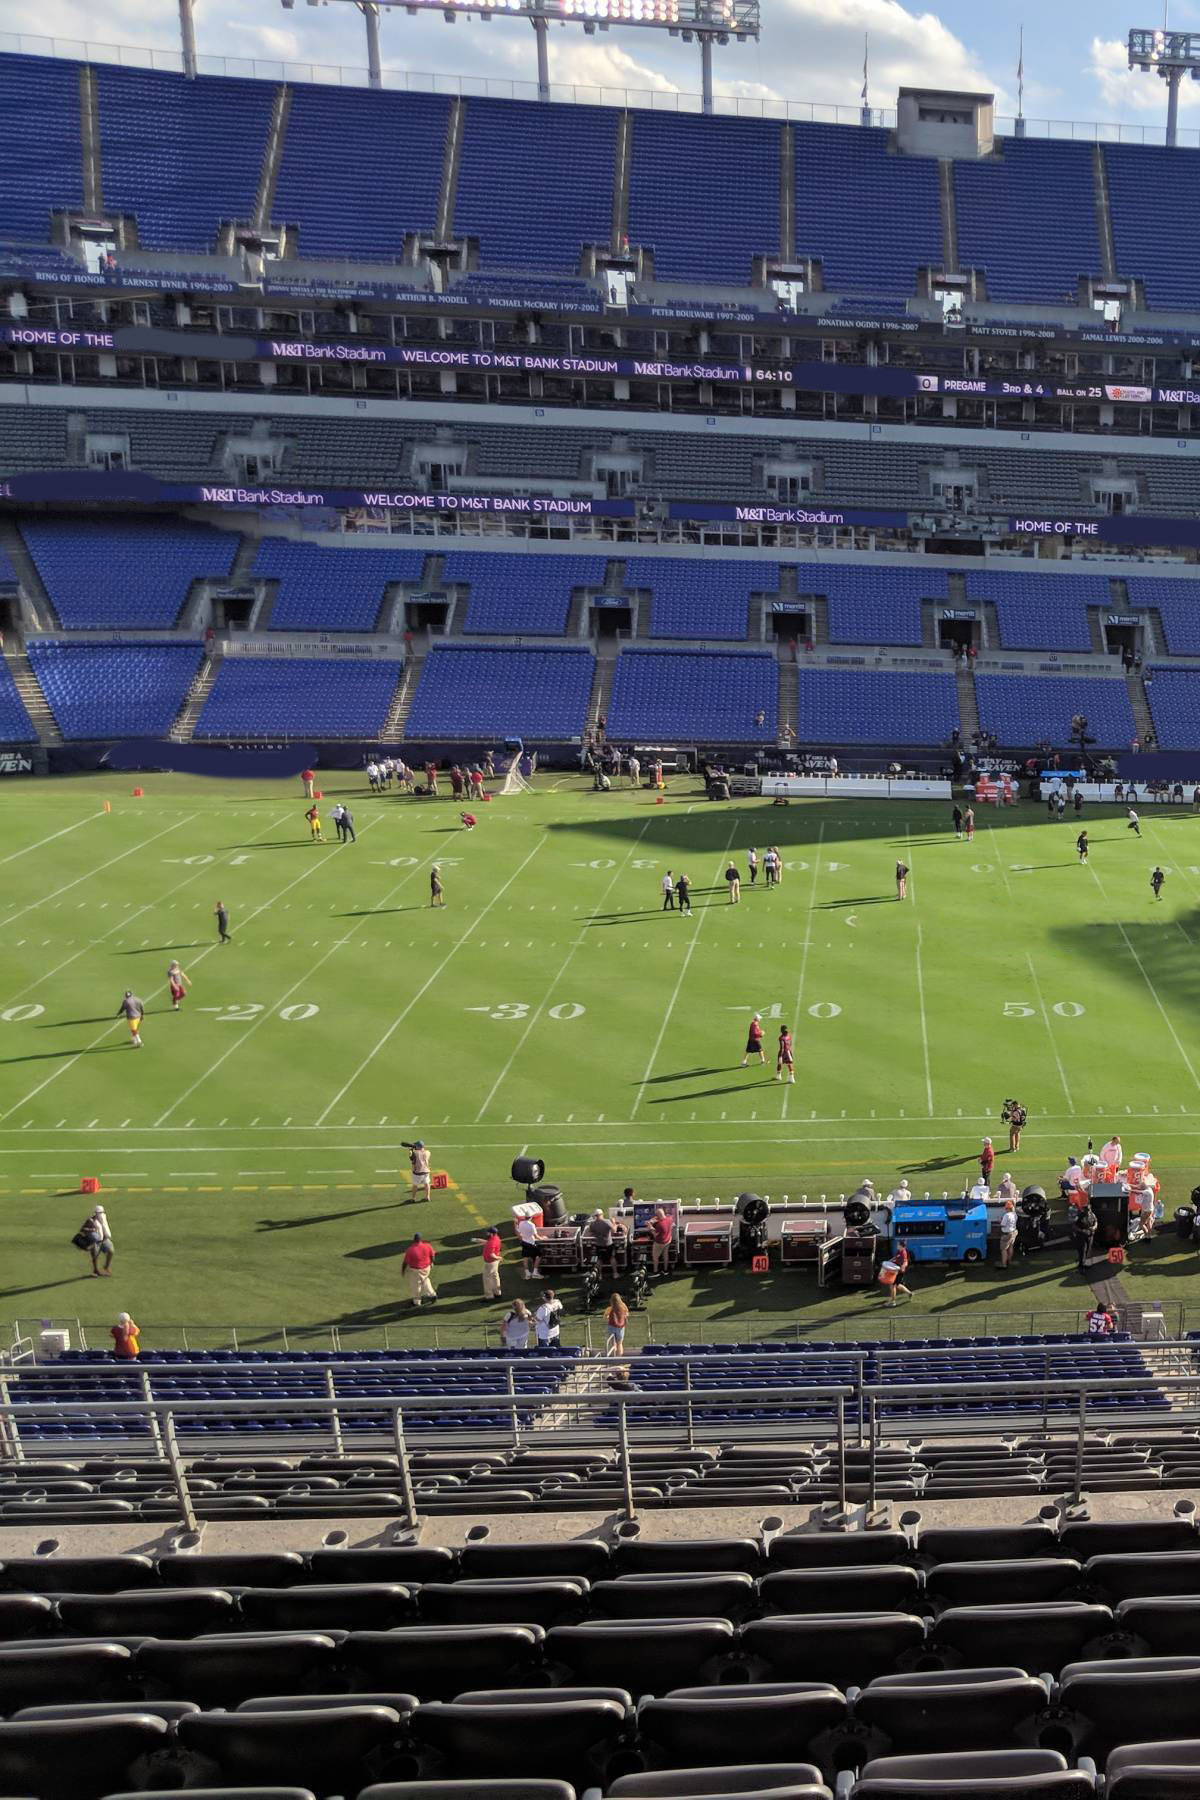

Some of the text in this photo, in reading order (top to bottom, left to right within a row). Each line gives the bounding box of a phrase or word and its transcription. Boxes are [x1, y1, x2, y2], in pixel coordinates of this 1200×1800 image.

[36, 272, 106, 285] RING OF HONOR
[122, 278, 158, 288] EARNEST
[160, 279, 188, 290] BYNER
[396, 293, 428, 302] ARTHUR
[438, 296, 469, 305] MODELL
[488, 298, 521, 308] MICHAEL
[651, 308, 674, 316] PETER
[675, 309, 714, 319] BOULWARE
[817, 318, 854, 328] JONATHAN
[855, 319, 880, 329] OGDEN
[971, 326, 990, 335] MATT
[991, 327, 1017, 336] STOVER
[1082, 332, 1104, 341] JAMAL
[1105, 334, 1126, 342] LEWIS
[12, 330, 114, 347] HOME OF THE
[272, 342, 386, 360] M&T Bank Stadium
[402, 350, 618, 372] WELCOME TO M&T BANK STADIUM
[633, 361, 739, 379] M&T Bank Stadium
[756, 369, 792, 381] 64:10
[922, 378, 931, 389] 0
[944, 379, 986, 391] PREGAME
[1002, 382, 1044, 394] 3RD & 4
[1056, 387, 1102, 398] BALL ON 25
[1158, 389, 1187, 402] M&T
[201, 488, 324, 505] M&T Bank Stadium
[364, 494, 592, 513] WELCOME TO M&T BANK STADIUM
[736, 507, 844, 524] M&T Bank Stadium
[1015, 520, 1099, 535] HOME OF THE
[489, 1002, 587, 1021] 30
[1002, 1001, 1087, 1018] 50
[433, 1174, 448, 1188] 30
[1111, 1249, 1124, 1263] 50
[754, 1257, 768, 1271] 40
[1089, 1317, 1106, 1333] 57
